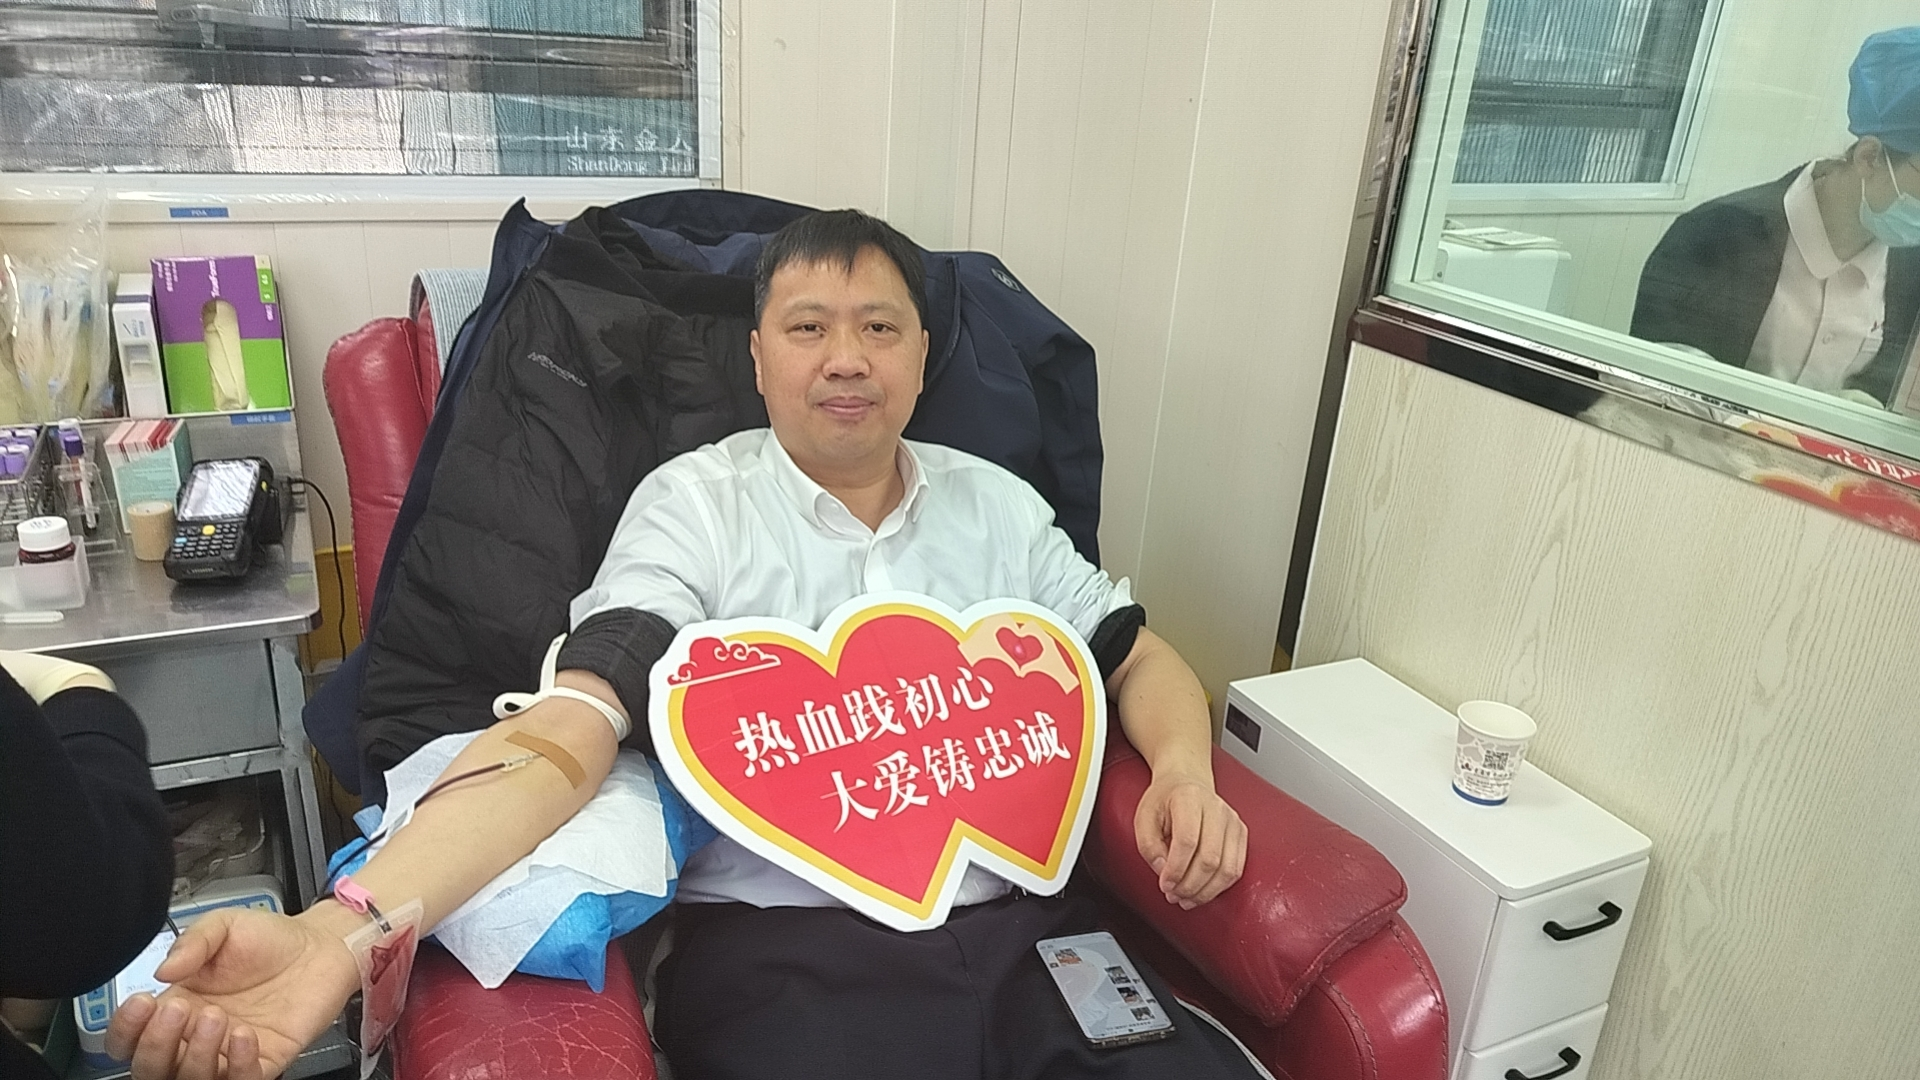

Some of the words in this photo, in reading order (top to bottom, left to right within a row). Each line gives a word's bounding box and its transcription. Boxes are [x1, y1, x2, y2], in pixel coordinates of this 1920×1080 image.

[732, 666, 994, 777] 热血践初心
[820, 711, 1071, 833] 大爱铸忠诚
